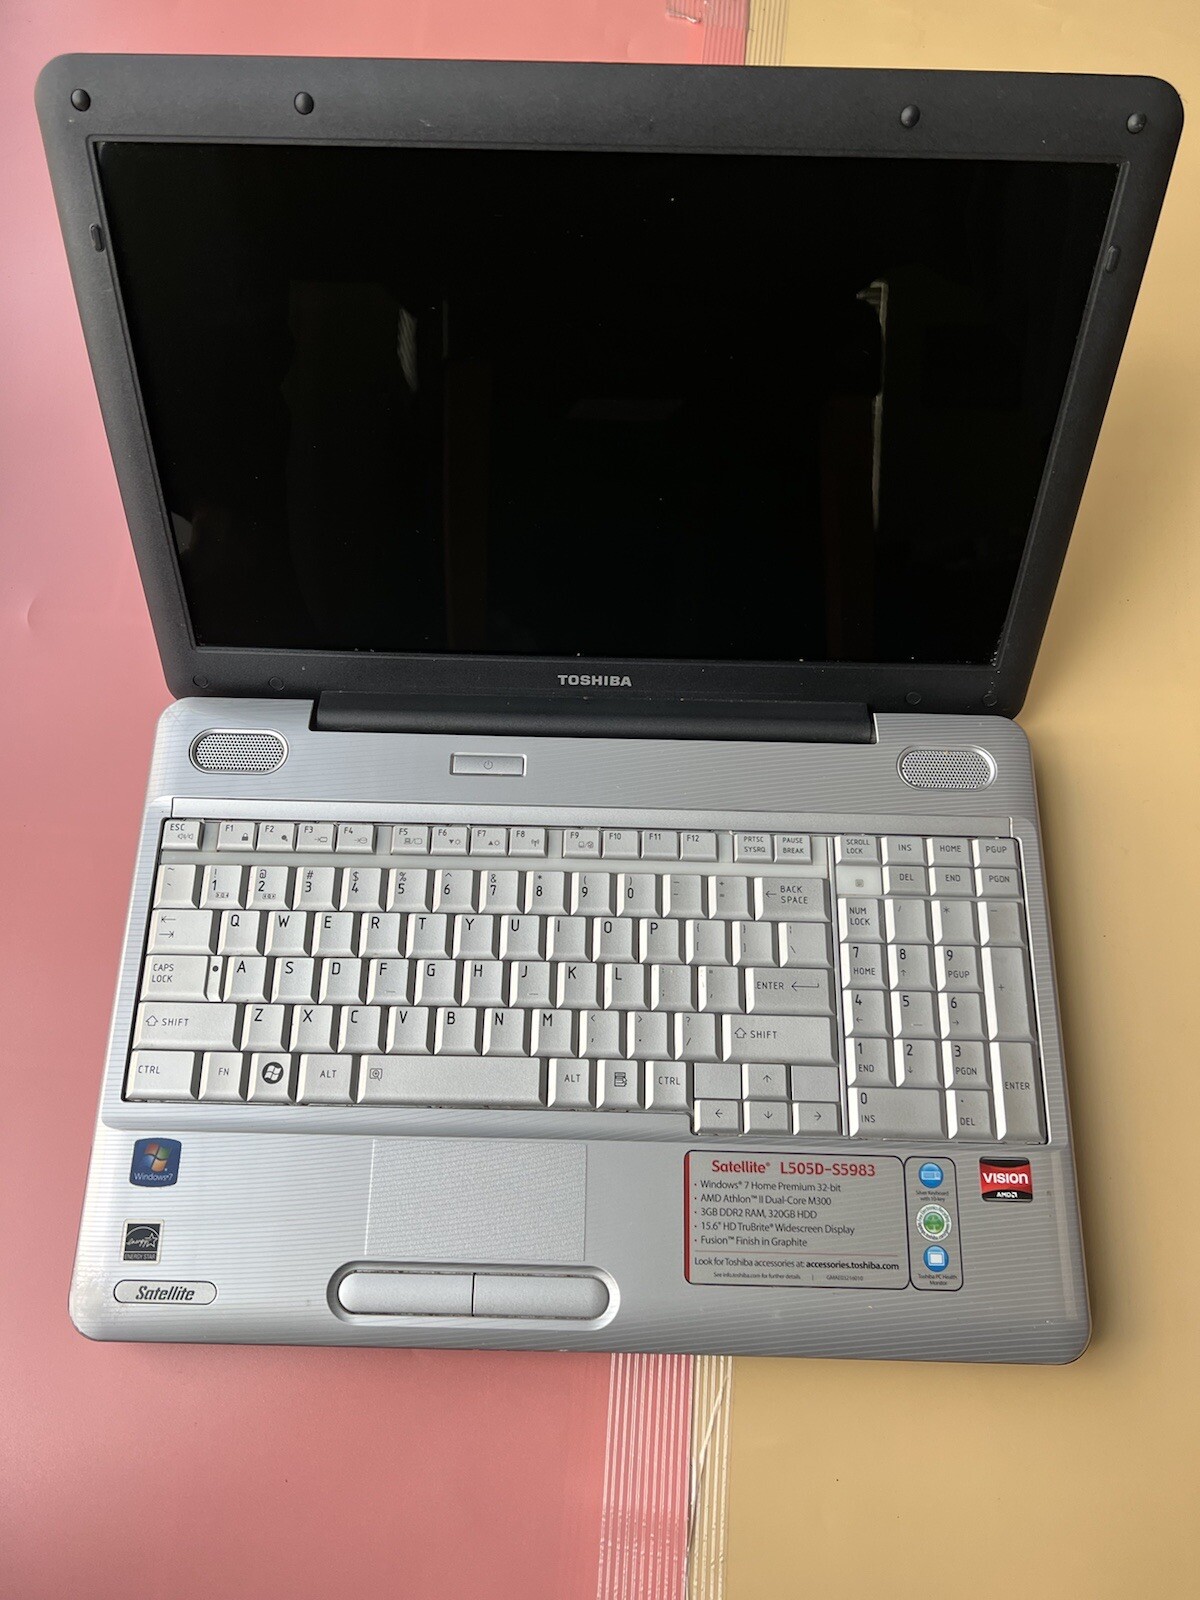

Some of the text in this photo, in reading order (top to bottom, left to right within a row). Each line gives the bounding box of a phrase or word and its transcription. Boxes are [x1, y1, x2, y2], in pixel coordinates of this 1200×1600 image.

[557, 674, 632, 687] TOSHIBA
[257, 881, 266, 892] 2
[304, 881, 313, 893] 3
[351, 883, 359, 894] 4
[398, 883, 405, 895] 5
[443, 885, 451, 895] 6
[490, 885, 497, 896] 7
[535, 886, 543, 897] 8
[581, 887, 589, 898] 9
[780, 885, 802, 893] BACK
[627, 888, 634, 899] 0
[781, 896, 807, 904] SPACE
[230, 914, 240, 927] Q
[278, 914, 291, 928] W
[323, 915, 332, 929] E
[370, 916, 380, 929] R
[418, 917, 427, 930] T
[465, 918, 475, 931] Y
[510, 918, 520, 932] U
[603, 920, 613, 934] O
[850, 918, 870, 926] LOCK
[650, 921, 659, 935] P
[852, 946, 859, 959] 7
[899, 948, 907, 960] 8
[946, 949, 954, 962] 9
[236, 960, 246, 974] A
[284, 961, 294, 975] S
[331, 961, 341, 976] D
[379, 962, 388, 976] F
[426, 963, 436, 977] G
[473, 964, 483, 978] H
[521, 965, 528, 979] J
[567, 966, 577, 980] K
[615, 966, 623, 981] L
[853, 967, 875, 976] HOME
[948, 970, 969, 978] PGUP
[757, 981, 784, 989] ENTER
[854, 993, 863, 1006] 4
[902, 994, 910, 1008] 5
[950, 996, 958, 1009] 6
[253, 1008, 264, 1022] Z
[302, 1009, 314, 1023] X
[350, 1009, 359, 1024] C
[399, 1010, 408, 1024] V
[446, 1011, 456, 1025] B
[494, 1012, 504, 1026] N
[542, 1013, 553, 1027] M
[162, 1018, 188, 1026] SHIFT
[750, 1030, 777, 1038] SHIFT
[905, 1043, 914, 1057] 2
[954, 1044, 962, 1058] 3
[138, 1065, 159, 1074] CTRL
[320, 1070, 336, 1078] ALT
[859, 1064, 874, 1072] END
[956, 1067, 977, 1075] PGDN
[564, 1074, 580, 1082] ALT
[658, 1075, 680, 1085] CTRL
[1005, 1082, 1030, 1090] ENTER
[860, 1091, 868, 1105] 0
[861, 1115, 875, 1123] INS
[960, 1117, 975, 1126] DEL
[780, 1161, 876, 1177] L505D-S5983
[744, 1181, 750, 1189] 7
[751, 1182, 777, 1190] Home
[778, 1182, 815, 1191] Premium
[817, 1183, 842, 1192] 32-bit
[700, 1194, 722, 1202] AMD
[765, 1195, 807, 1205] Dual-Core
[808, 1197, 832, 1205] M300
[701, 1207, 718, 1216] 3GB
[719, 1208, 743, 1217] DDR2
[768, 1210, 796, 1218] 320GB
[797, 1210, 818, 1219] HDD
[723, 1222, 737, 1231] HD
[775, 1223, 823, 1233] Widescreen
[825, 1225, 855, 1236] Display
[736, 1236, 760, 1245] Finish
[761, 1237, 769, 1245] in
[771, 1237, 807, 1248] Graphite
[694, 1257, 712, 1266] Look
[713, 1257, 724, 1266] for
[725, 1258, 753, 1267] Toshiba
[754, 1259, 795, 1268] accessories
[806, 1260, 899, 1270] accessories.toshiba.com
[135, 1285, 195, 1301] Satellite
